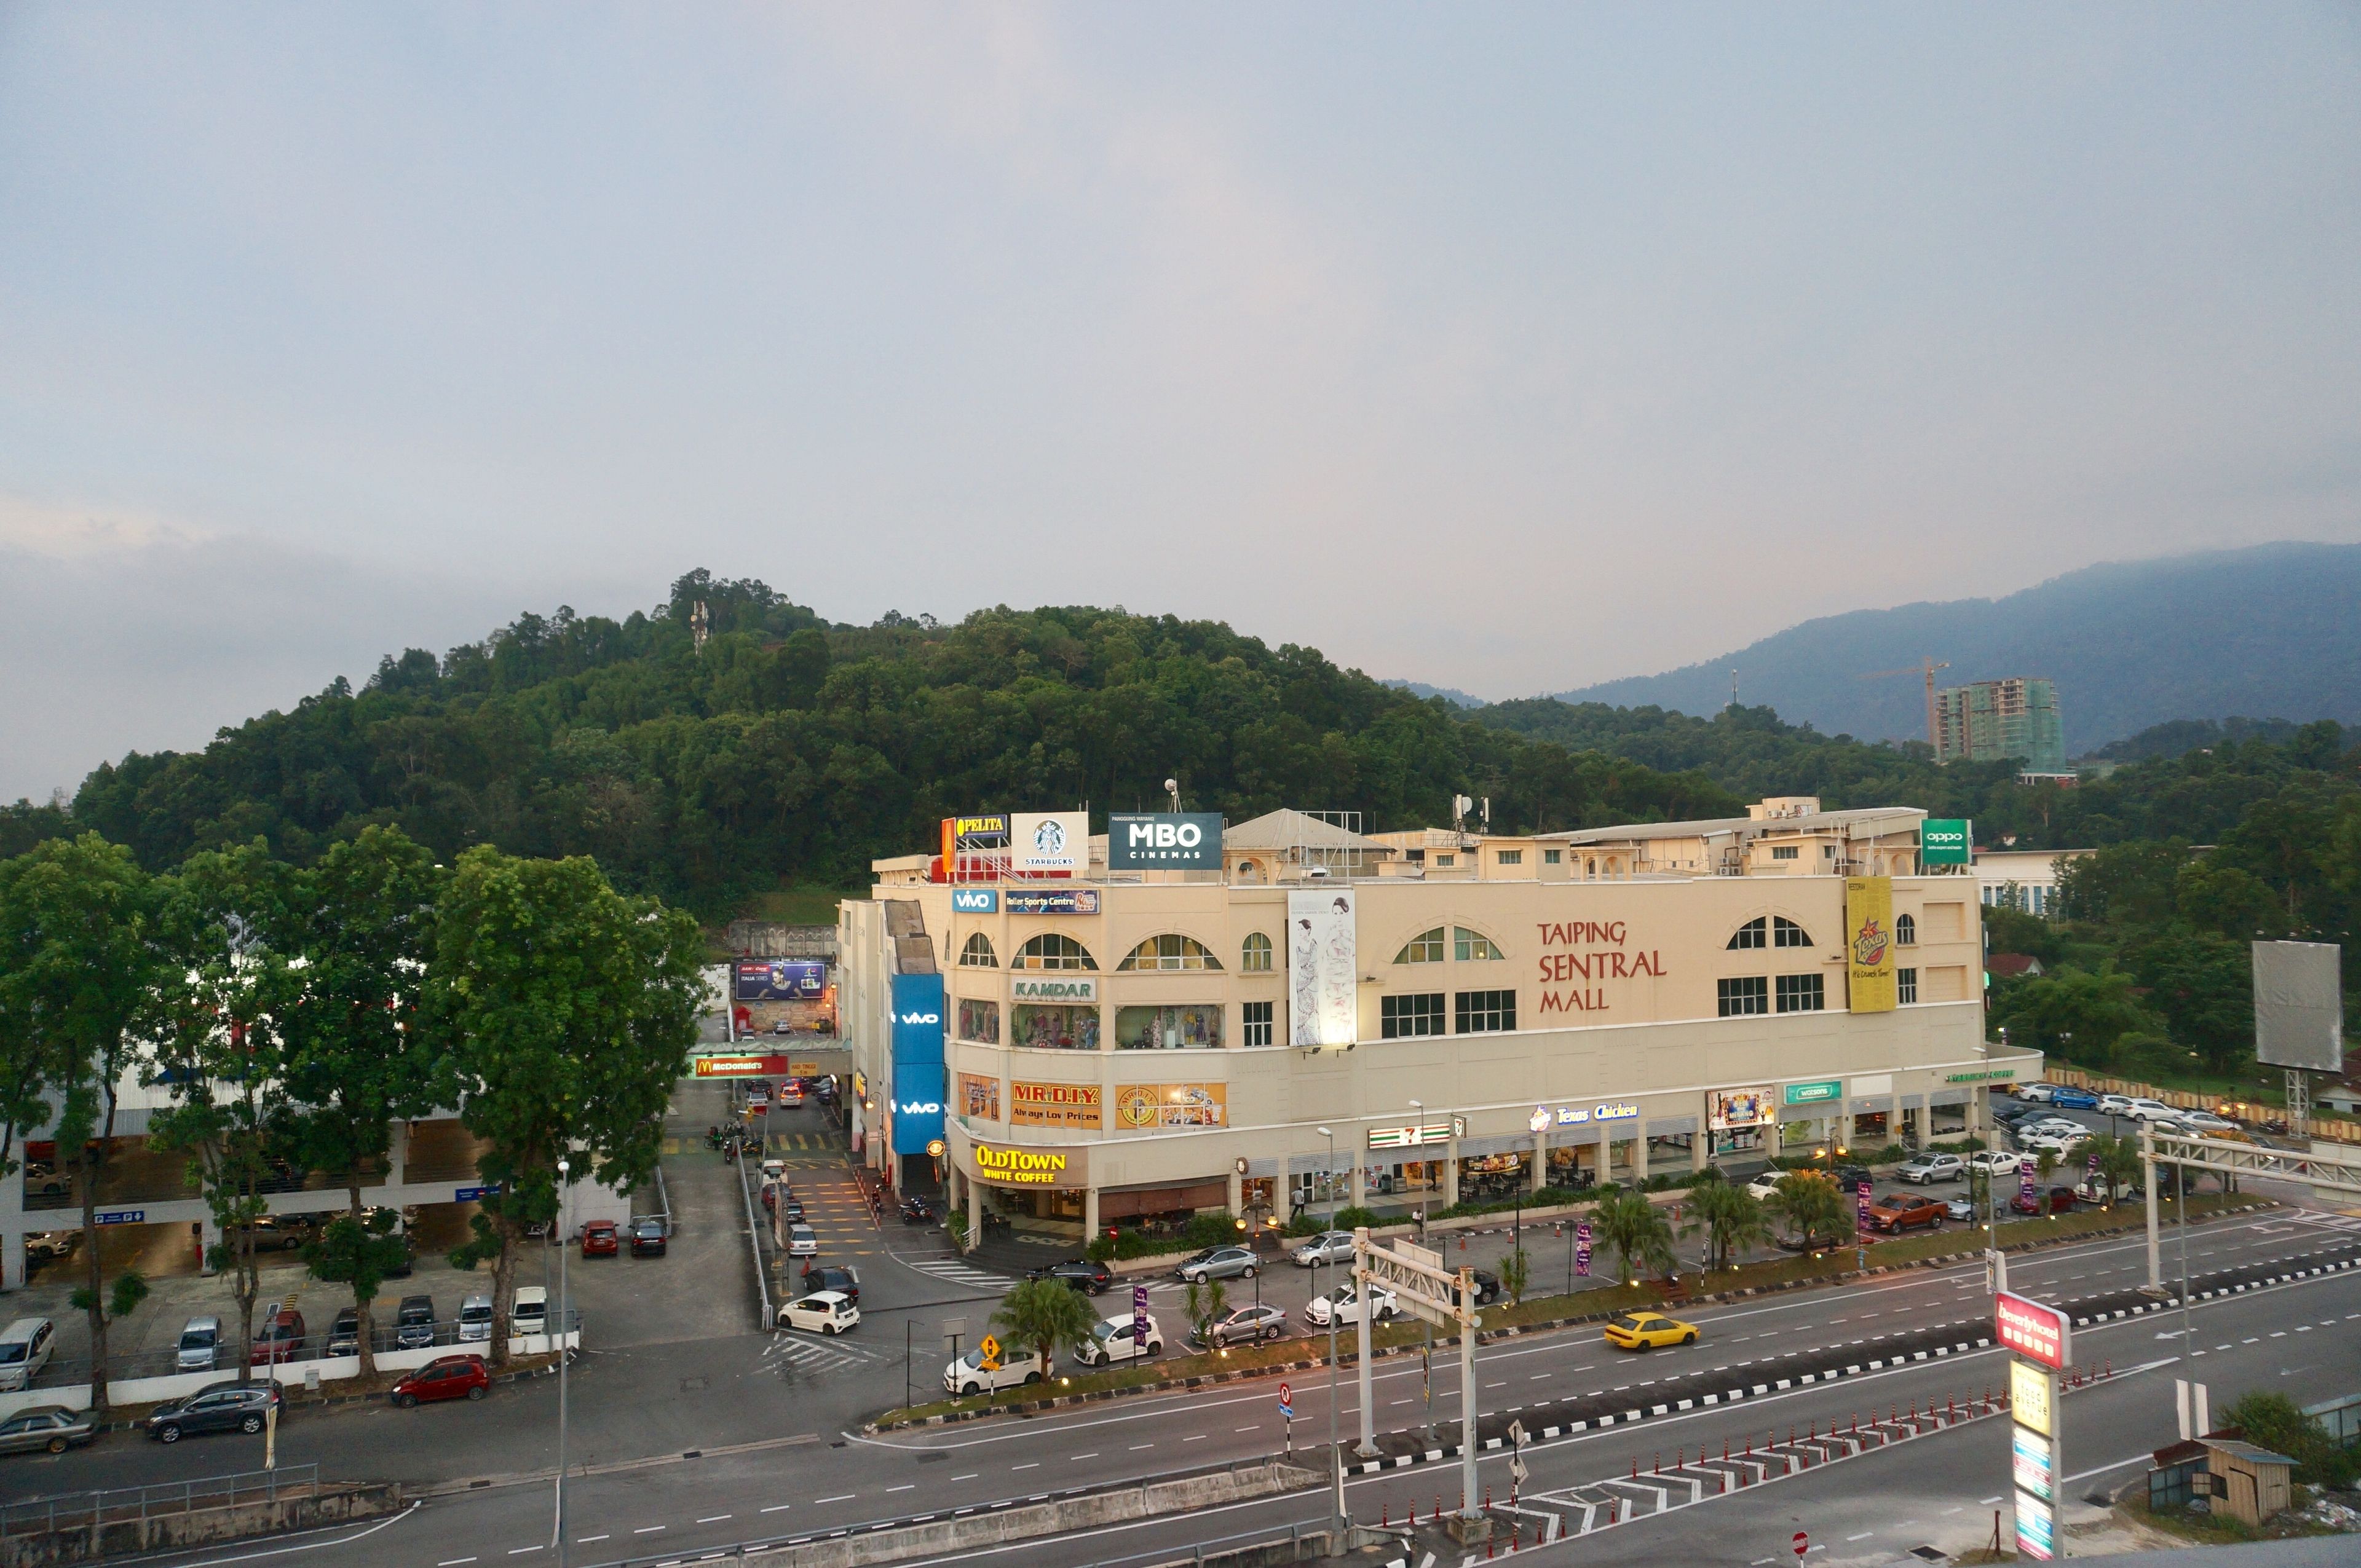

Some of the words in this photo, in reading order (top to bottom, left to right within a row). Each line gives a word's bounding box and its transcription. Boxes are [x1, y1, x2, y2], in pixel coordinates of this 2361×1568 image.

[965, 817, 1003, 832] PELITA
[1129, 823, 1201, 848] MBO
[1927, 833, 1963, 842] oppo
[1024, 897, 1048, 907] Sports
[1049, 897, 1075, 905] Centre
[1537, 921, 1626, 946] TAIPING
[1854, 931, 1888, 961] Texas
[1540, 950, 1667, 982] SENTRAL
[1016, 982, 1091, 997] KAMDAR
[1540, 988, 1610, 1013] MALL
[902, 1012, 938, 1023] vivo
[902, 1101, 939, 1114] vivo
[1013, 1108, 1043, 1119] Always
[1067, 1112, 1099, 1121] Prices
[1557, 1108, 1589, 1124] Texas
[1594, 1103, 1638, 1120] Chicken
[983, 1168, 1012, 1181] WHITE
[1015, 1172, 1054, 1183] COFFEE
